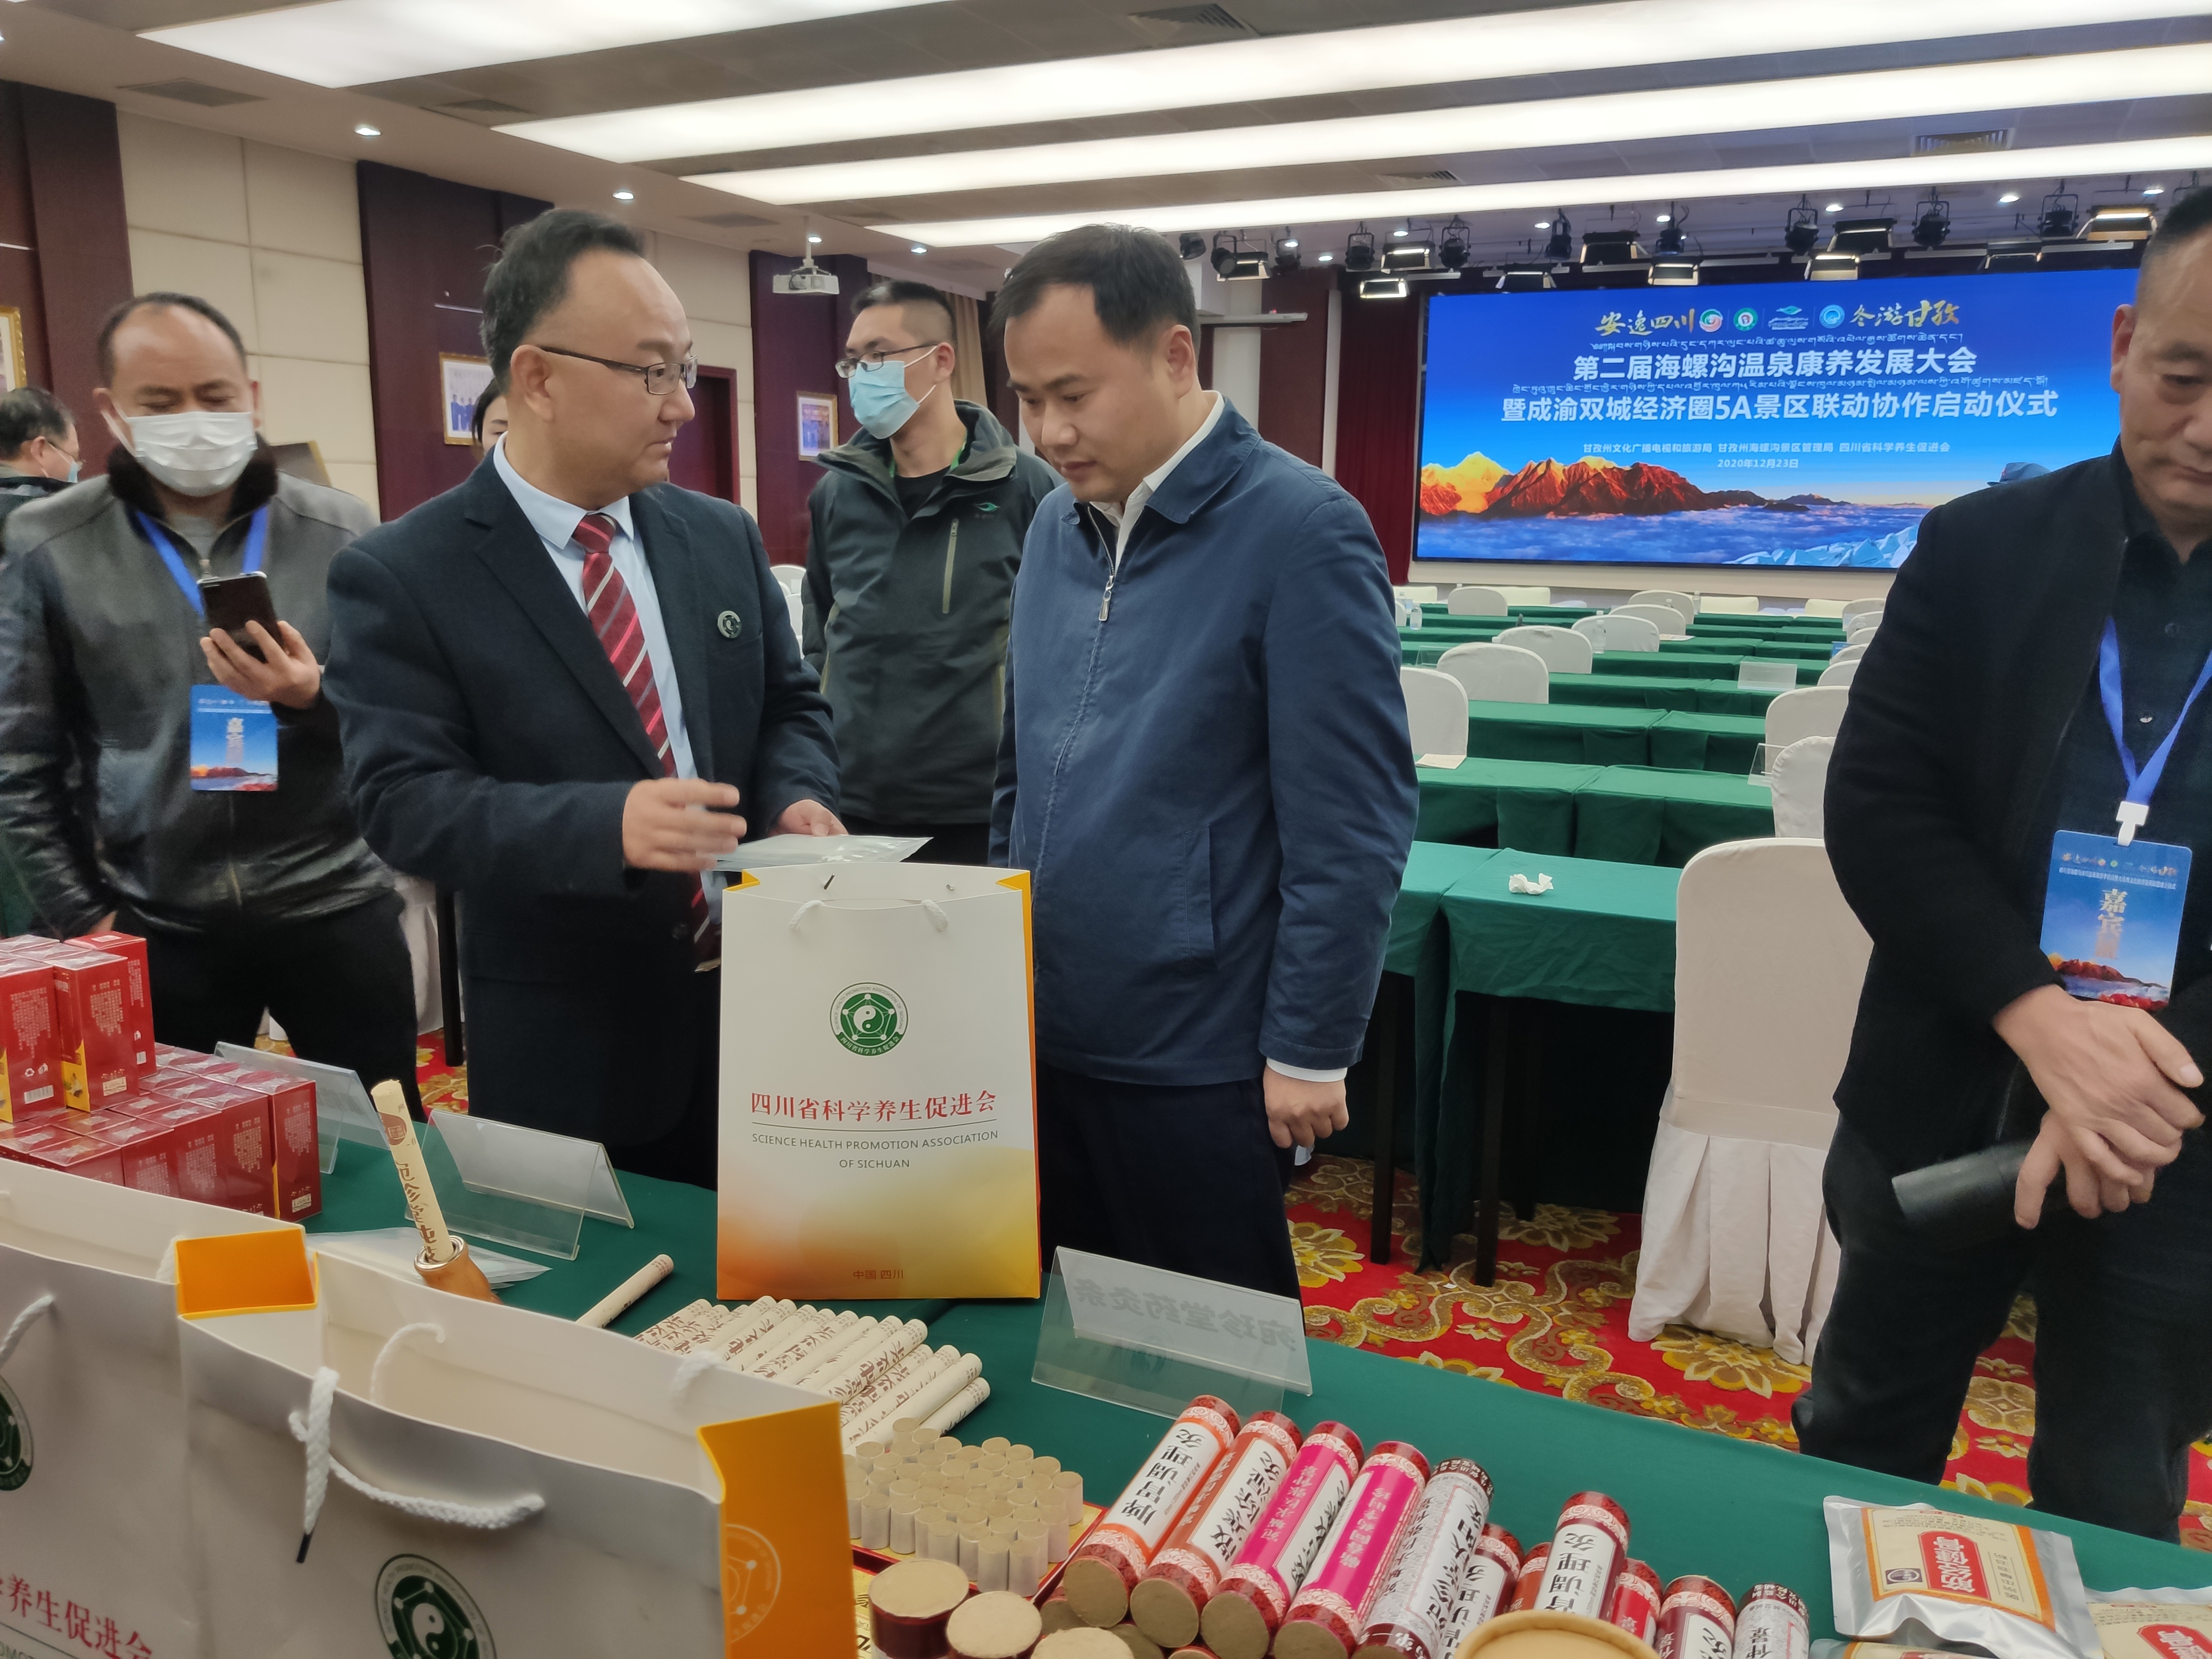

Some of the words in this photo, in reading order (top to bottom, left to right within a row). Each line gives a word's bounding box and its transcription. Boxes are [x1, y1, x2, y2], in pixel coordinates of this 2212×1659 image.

[1595, 308, 1695, 336] 安逸四川
[1573, 347, 1978, 381] 第二届海螺沟温泉康养发展大会
[1501, 390, 2059, 421] 暨成渝双城经济圈5A景区联动协作启动仪式
[1583, 444, 1713, 453] 甘孜州文化广播电视和旅游局
[1718, 443, 1834, 453] 甘孜州海螺沟景区管理局
[1839, 442, 1950, 452] 四川省科学养生促进会
[1718, 459, 1798, 468] 2020年12月23日
[751, 1090, 997, 1123] 四川省科学养生促进会
[752, 1133, 797, 1147] SCIENCE
[800, 1138, 843, 1150] HEALTH
[846, 1140, 919, 1150] PROMOTION
[922, 1130, 999, 1149] ASSOCIATION
[839, 1159, 854, 1168] OF
[857, 1159, 910, 1168] SICHUAN
[853, 1270, 877, 1280] 中国
[880, 1269, 904, 1280] 四川
[1122, 1428, 1206, 1526] 脾胃调理灸
[1215, 1450, 1286, 1562] 散寒除湿灸
[0, 1573, 153, 1659] 养生促进会
